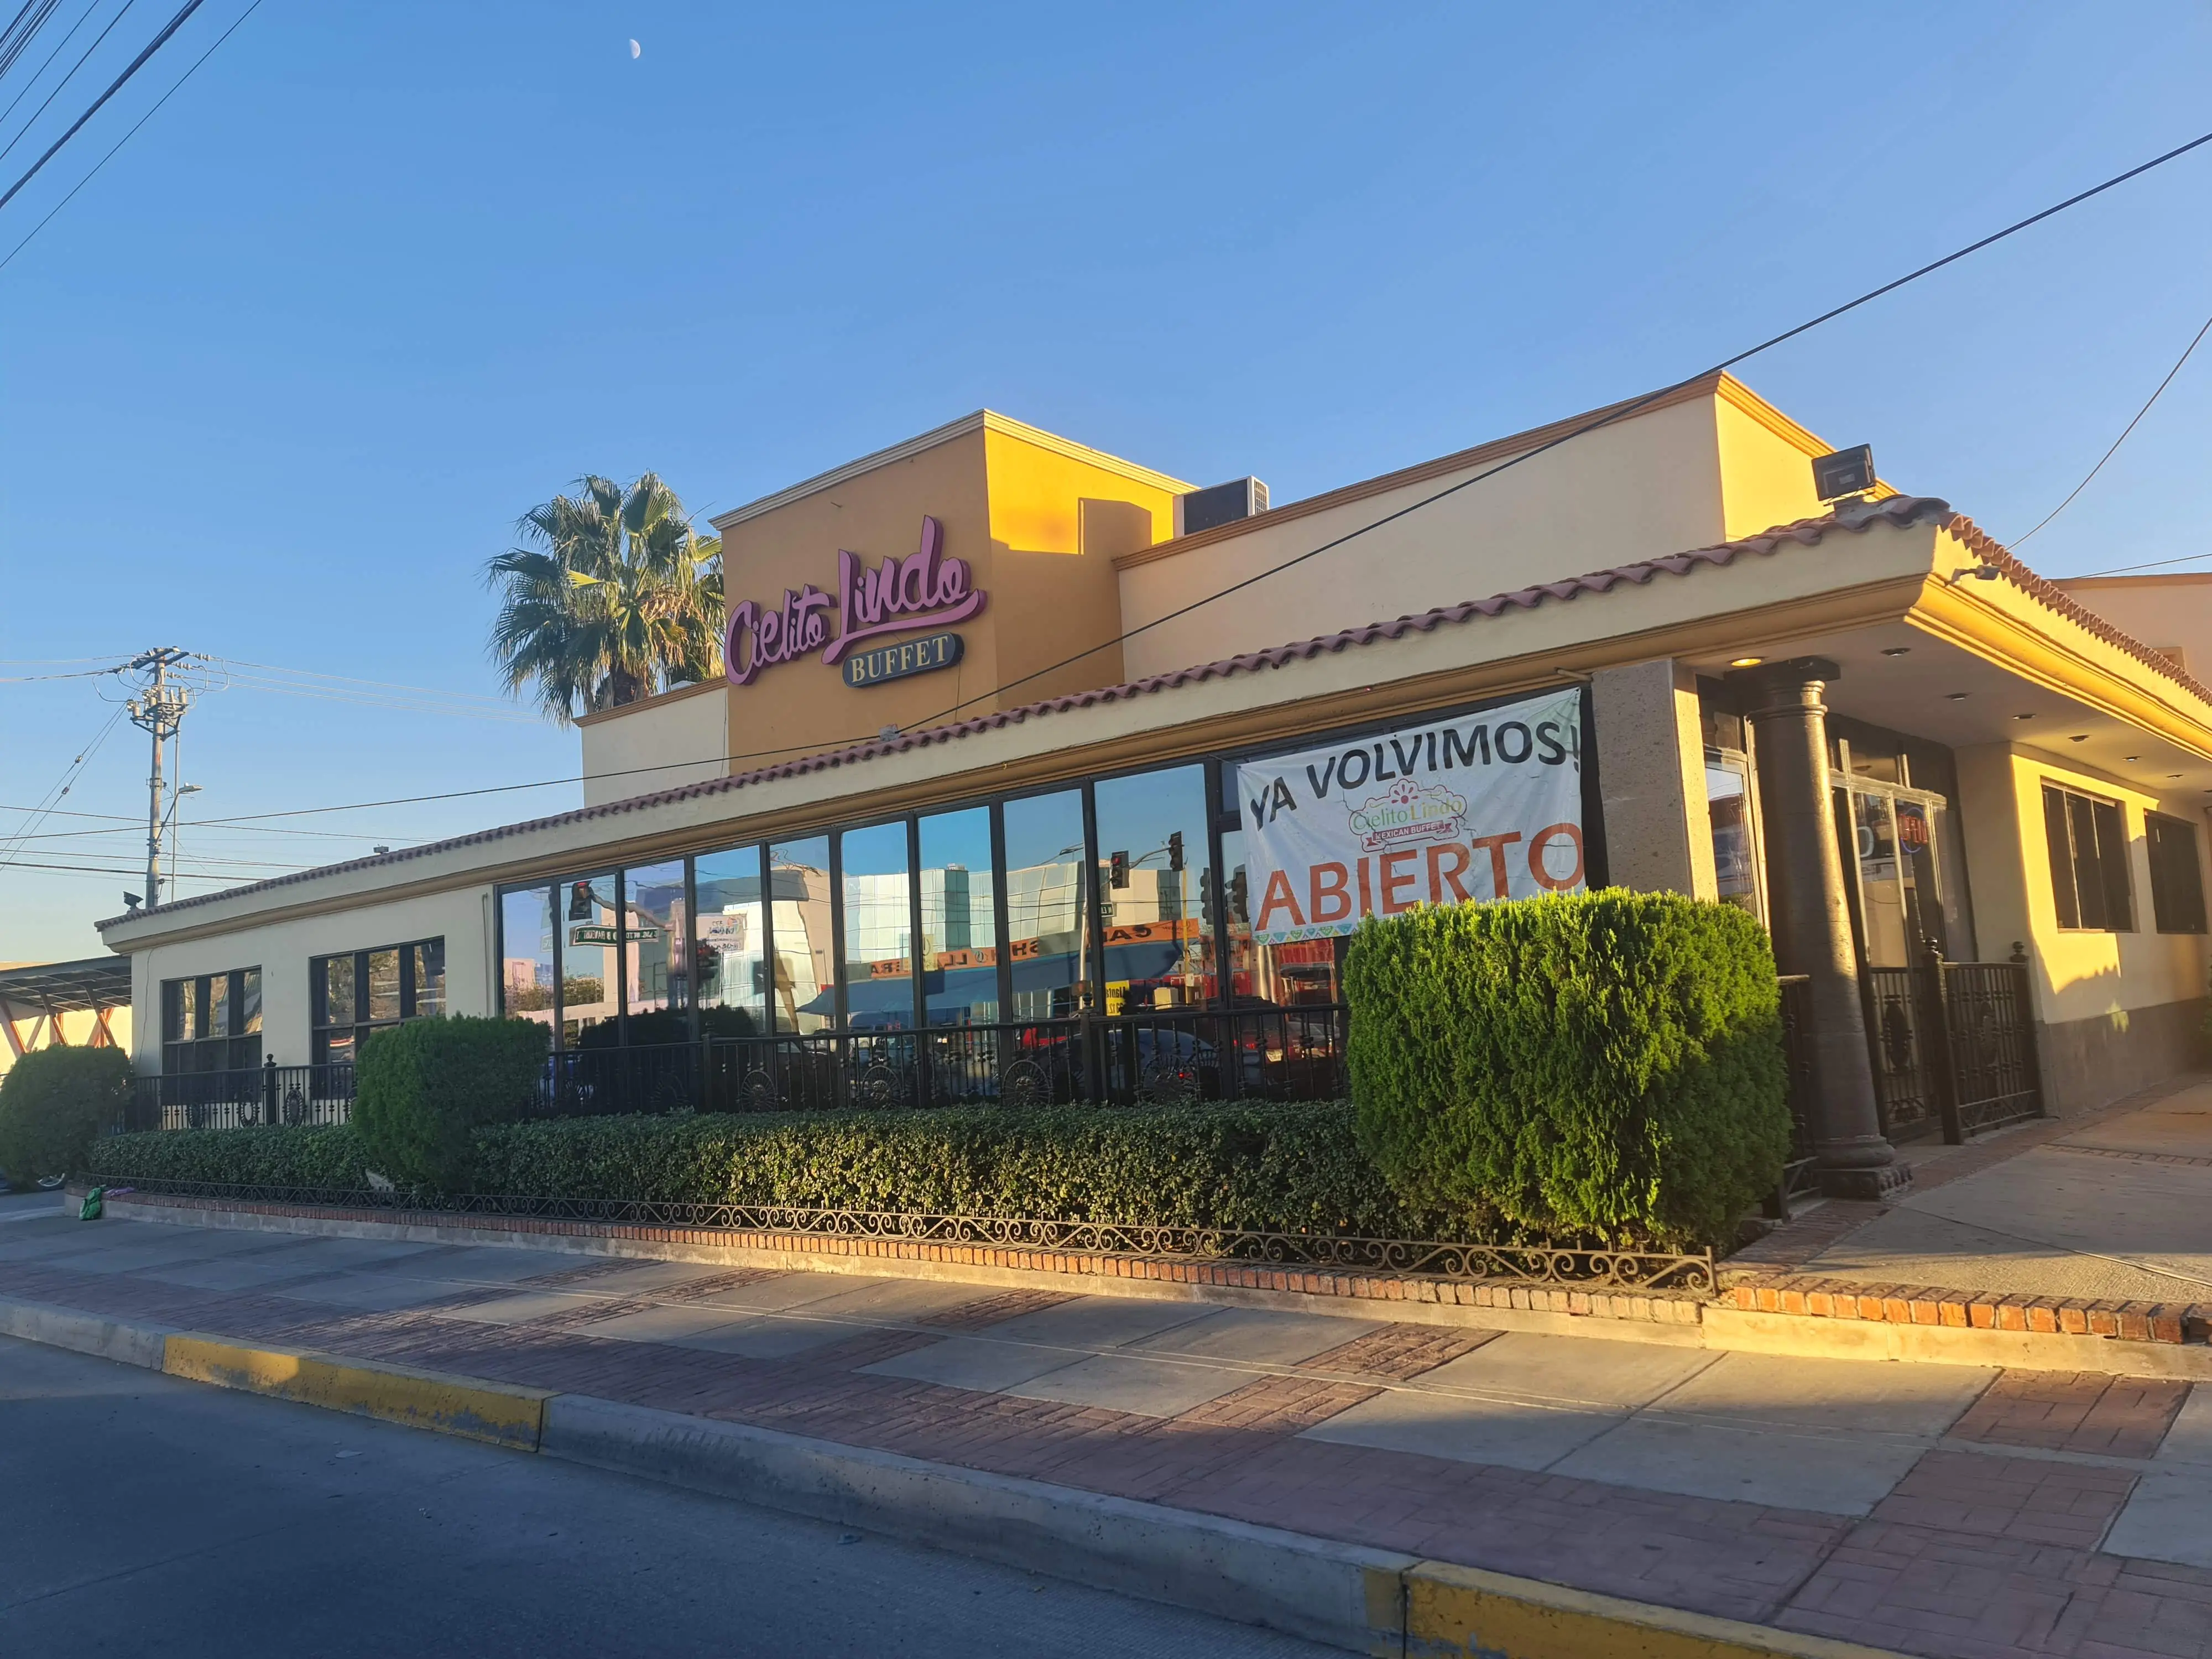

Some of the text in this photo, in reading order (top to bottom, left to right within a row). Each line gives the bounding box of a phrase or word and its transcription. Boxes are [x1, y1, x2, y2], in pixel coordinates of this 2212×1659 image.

[725, 515, 987, 685] Cielito Lindo
[851, 635, 948, 683] BUFFET
[1250, 721, 1579, 831] YA VOLVIMOS!
[1353, 797, 1462, 830] Cielito Lindo
[1375, 828, 1409, 840] MEXICAN
[1255, 822, 1583, 931] ABIERTO
